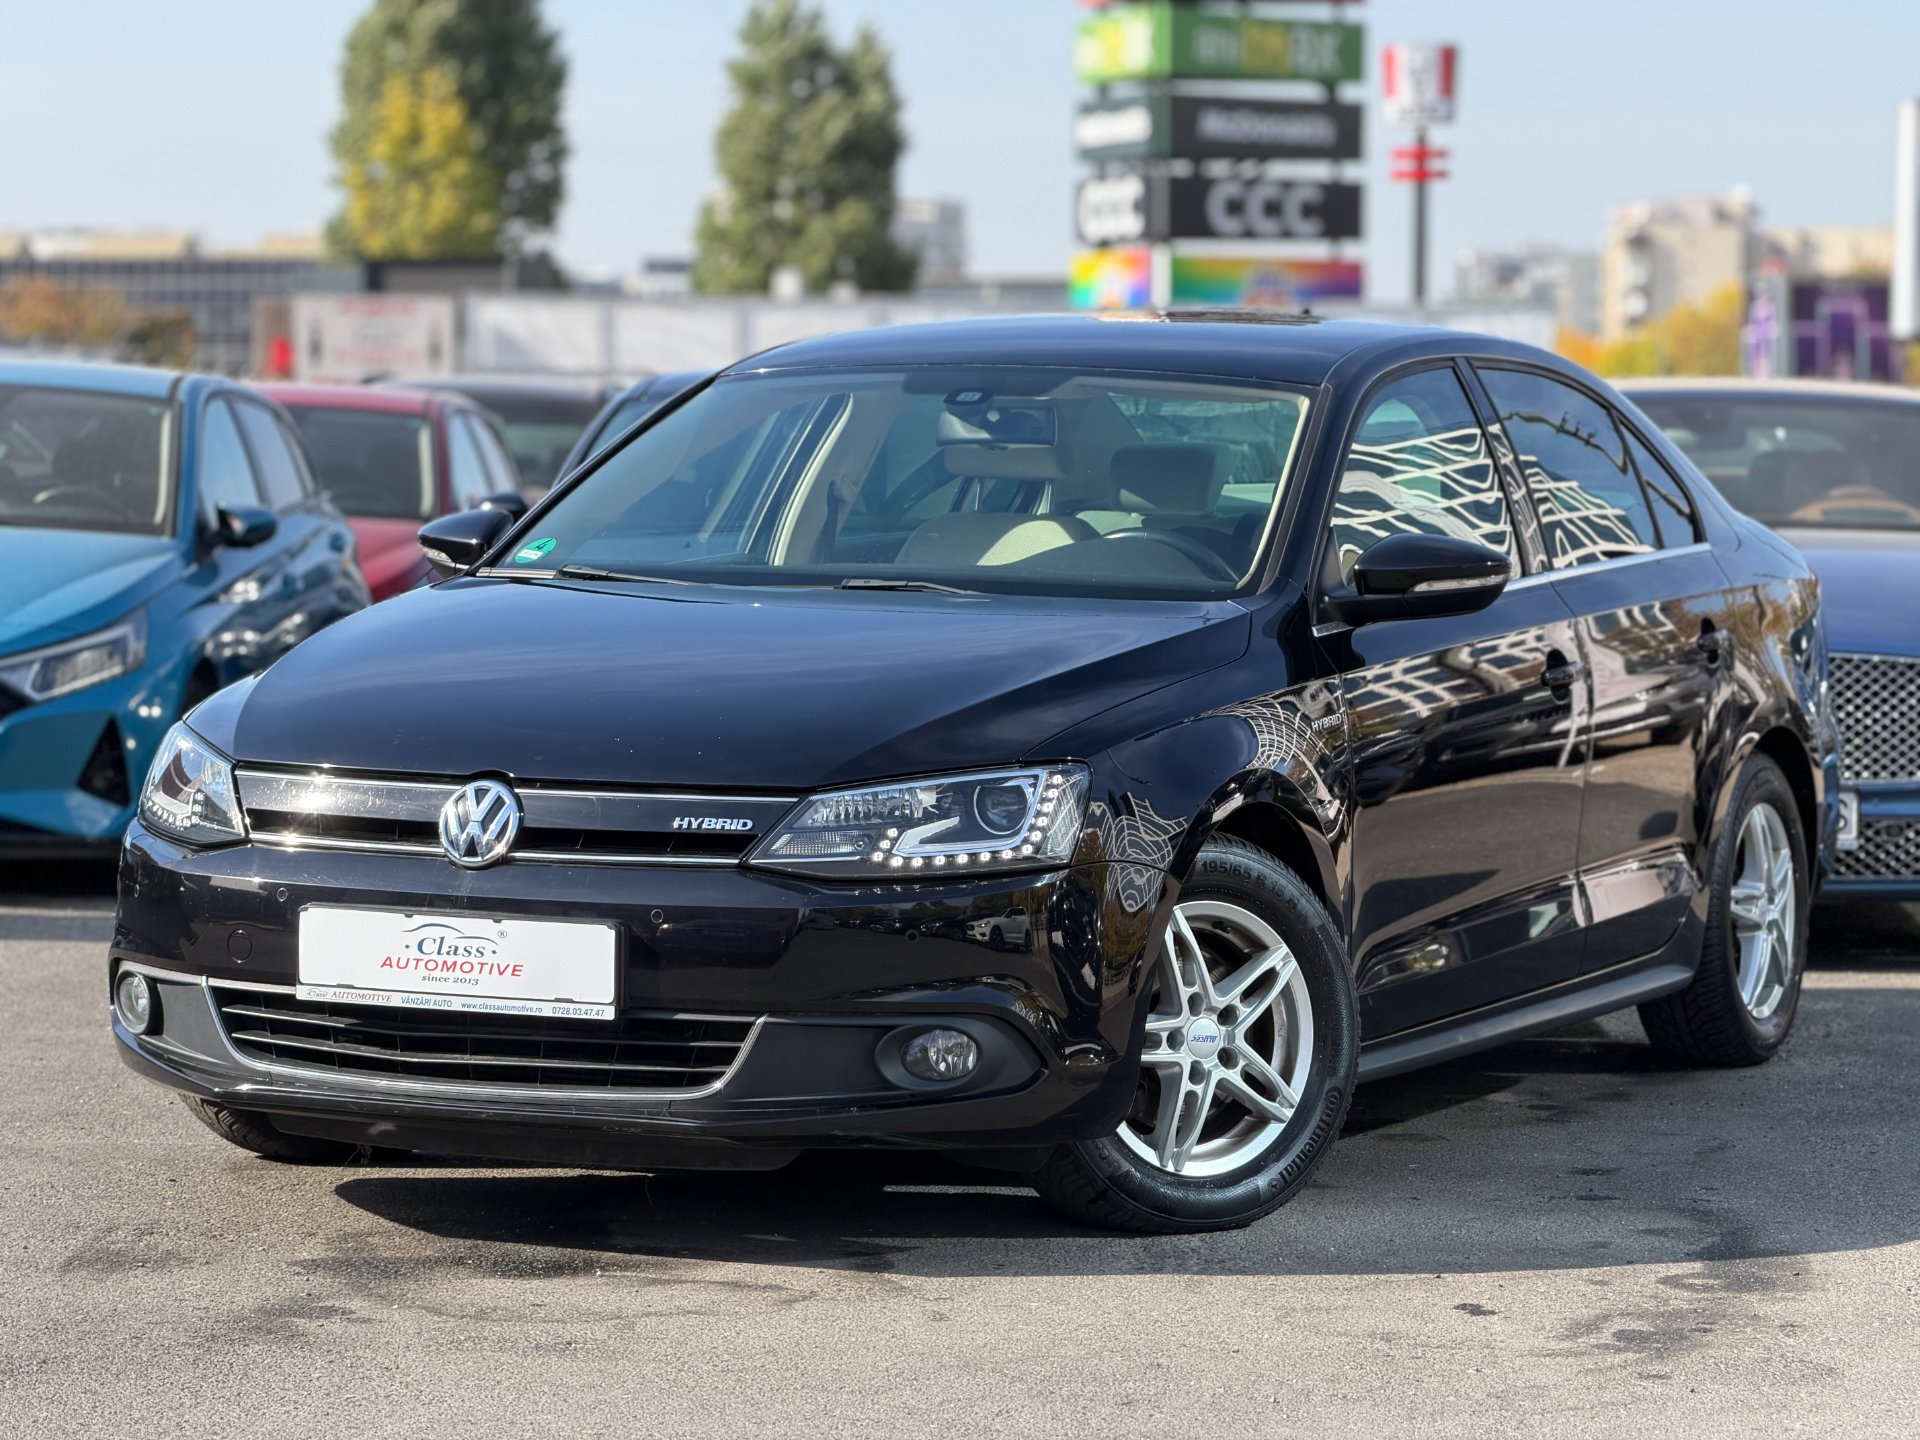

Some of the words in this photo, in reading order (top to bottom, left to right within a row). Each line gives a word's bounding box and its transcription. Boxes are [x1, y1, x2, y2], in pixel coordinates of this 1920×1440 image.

[1206, 180, 1326, 236] CCC
[1311, 714, 1341, 732] HYBRID
[673, 817, 753, 830] HYBRID
[417, 936, 485, 958] Class
[380, 956, 524, 977] AUTOMOTIVE
[421, 974, 450, 983] since
[452, 977, 479, 986] 2013
[331, 991, 393, 1003] AUTOMOTIVE
[432, 999, 452, 1007] AUTO
[461, 1001, 543, 1014] www.classautomotive.ro
[552, 1006, 605, 1017] 0728.03.47.47
